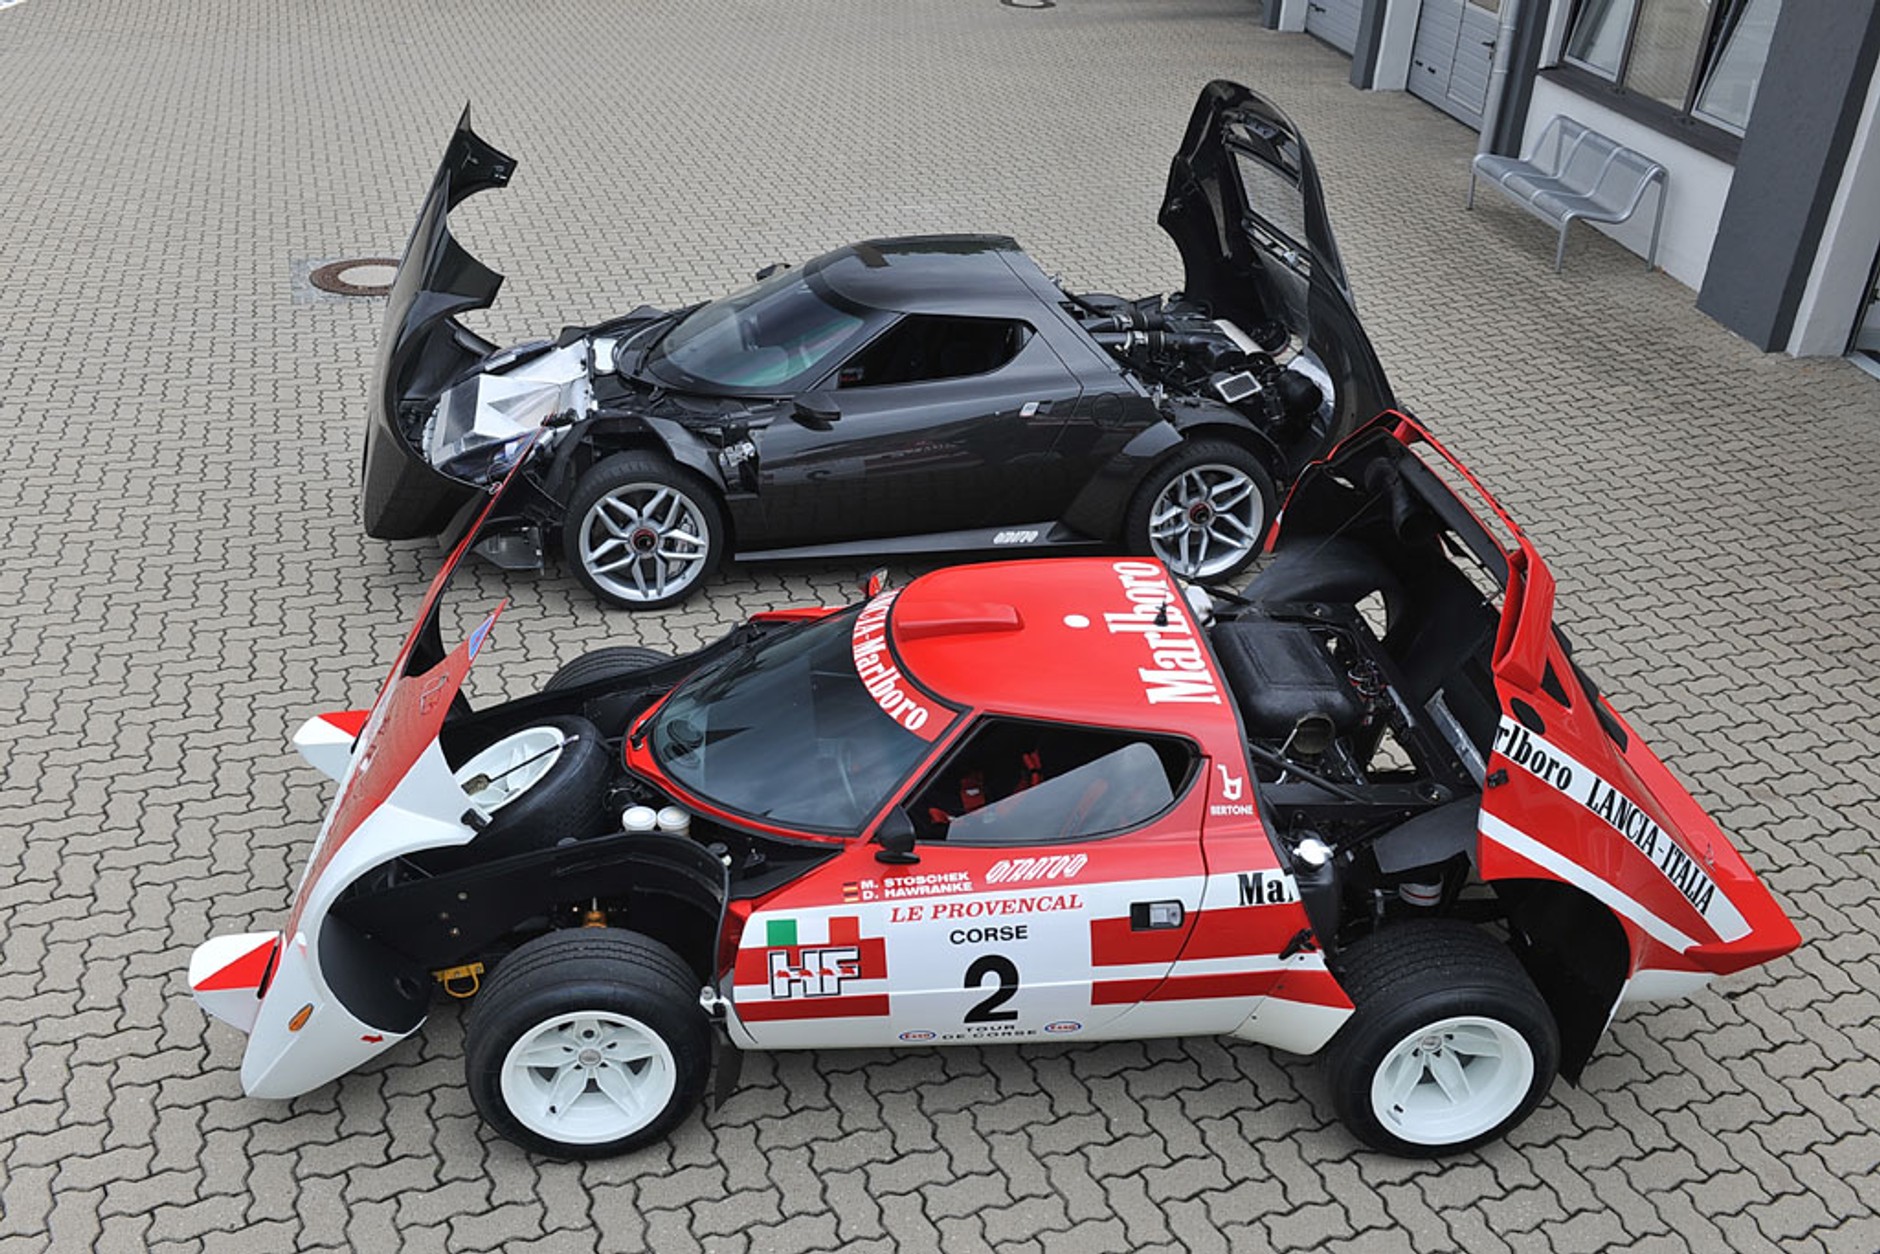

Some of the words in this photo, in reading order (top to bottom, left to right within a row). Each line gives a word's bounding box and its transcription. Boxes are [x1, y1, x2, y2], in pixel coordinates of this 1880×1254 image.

[1103, 561, 1222, 705] Marlboro
[1210, 804, 1254, 816] BERTONE
[861, 879, 879, 890] M.
[884, 871, 970, 888] STOSCHEK
[862, 890, 879, 901] D.
[884, 881, 973, 899] HAWRANKE
[1237, 871, 1294, 906] Ma
[890, 905, 924, 924] LE
[930, 894, 1084, 920] PROVENCAL
[949, 925, 1028, 945] CORSE
[768, 946, 861, 999] HF
[963, 954, 1020, 1024] 2
